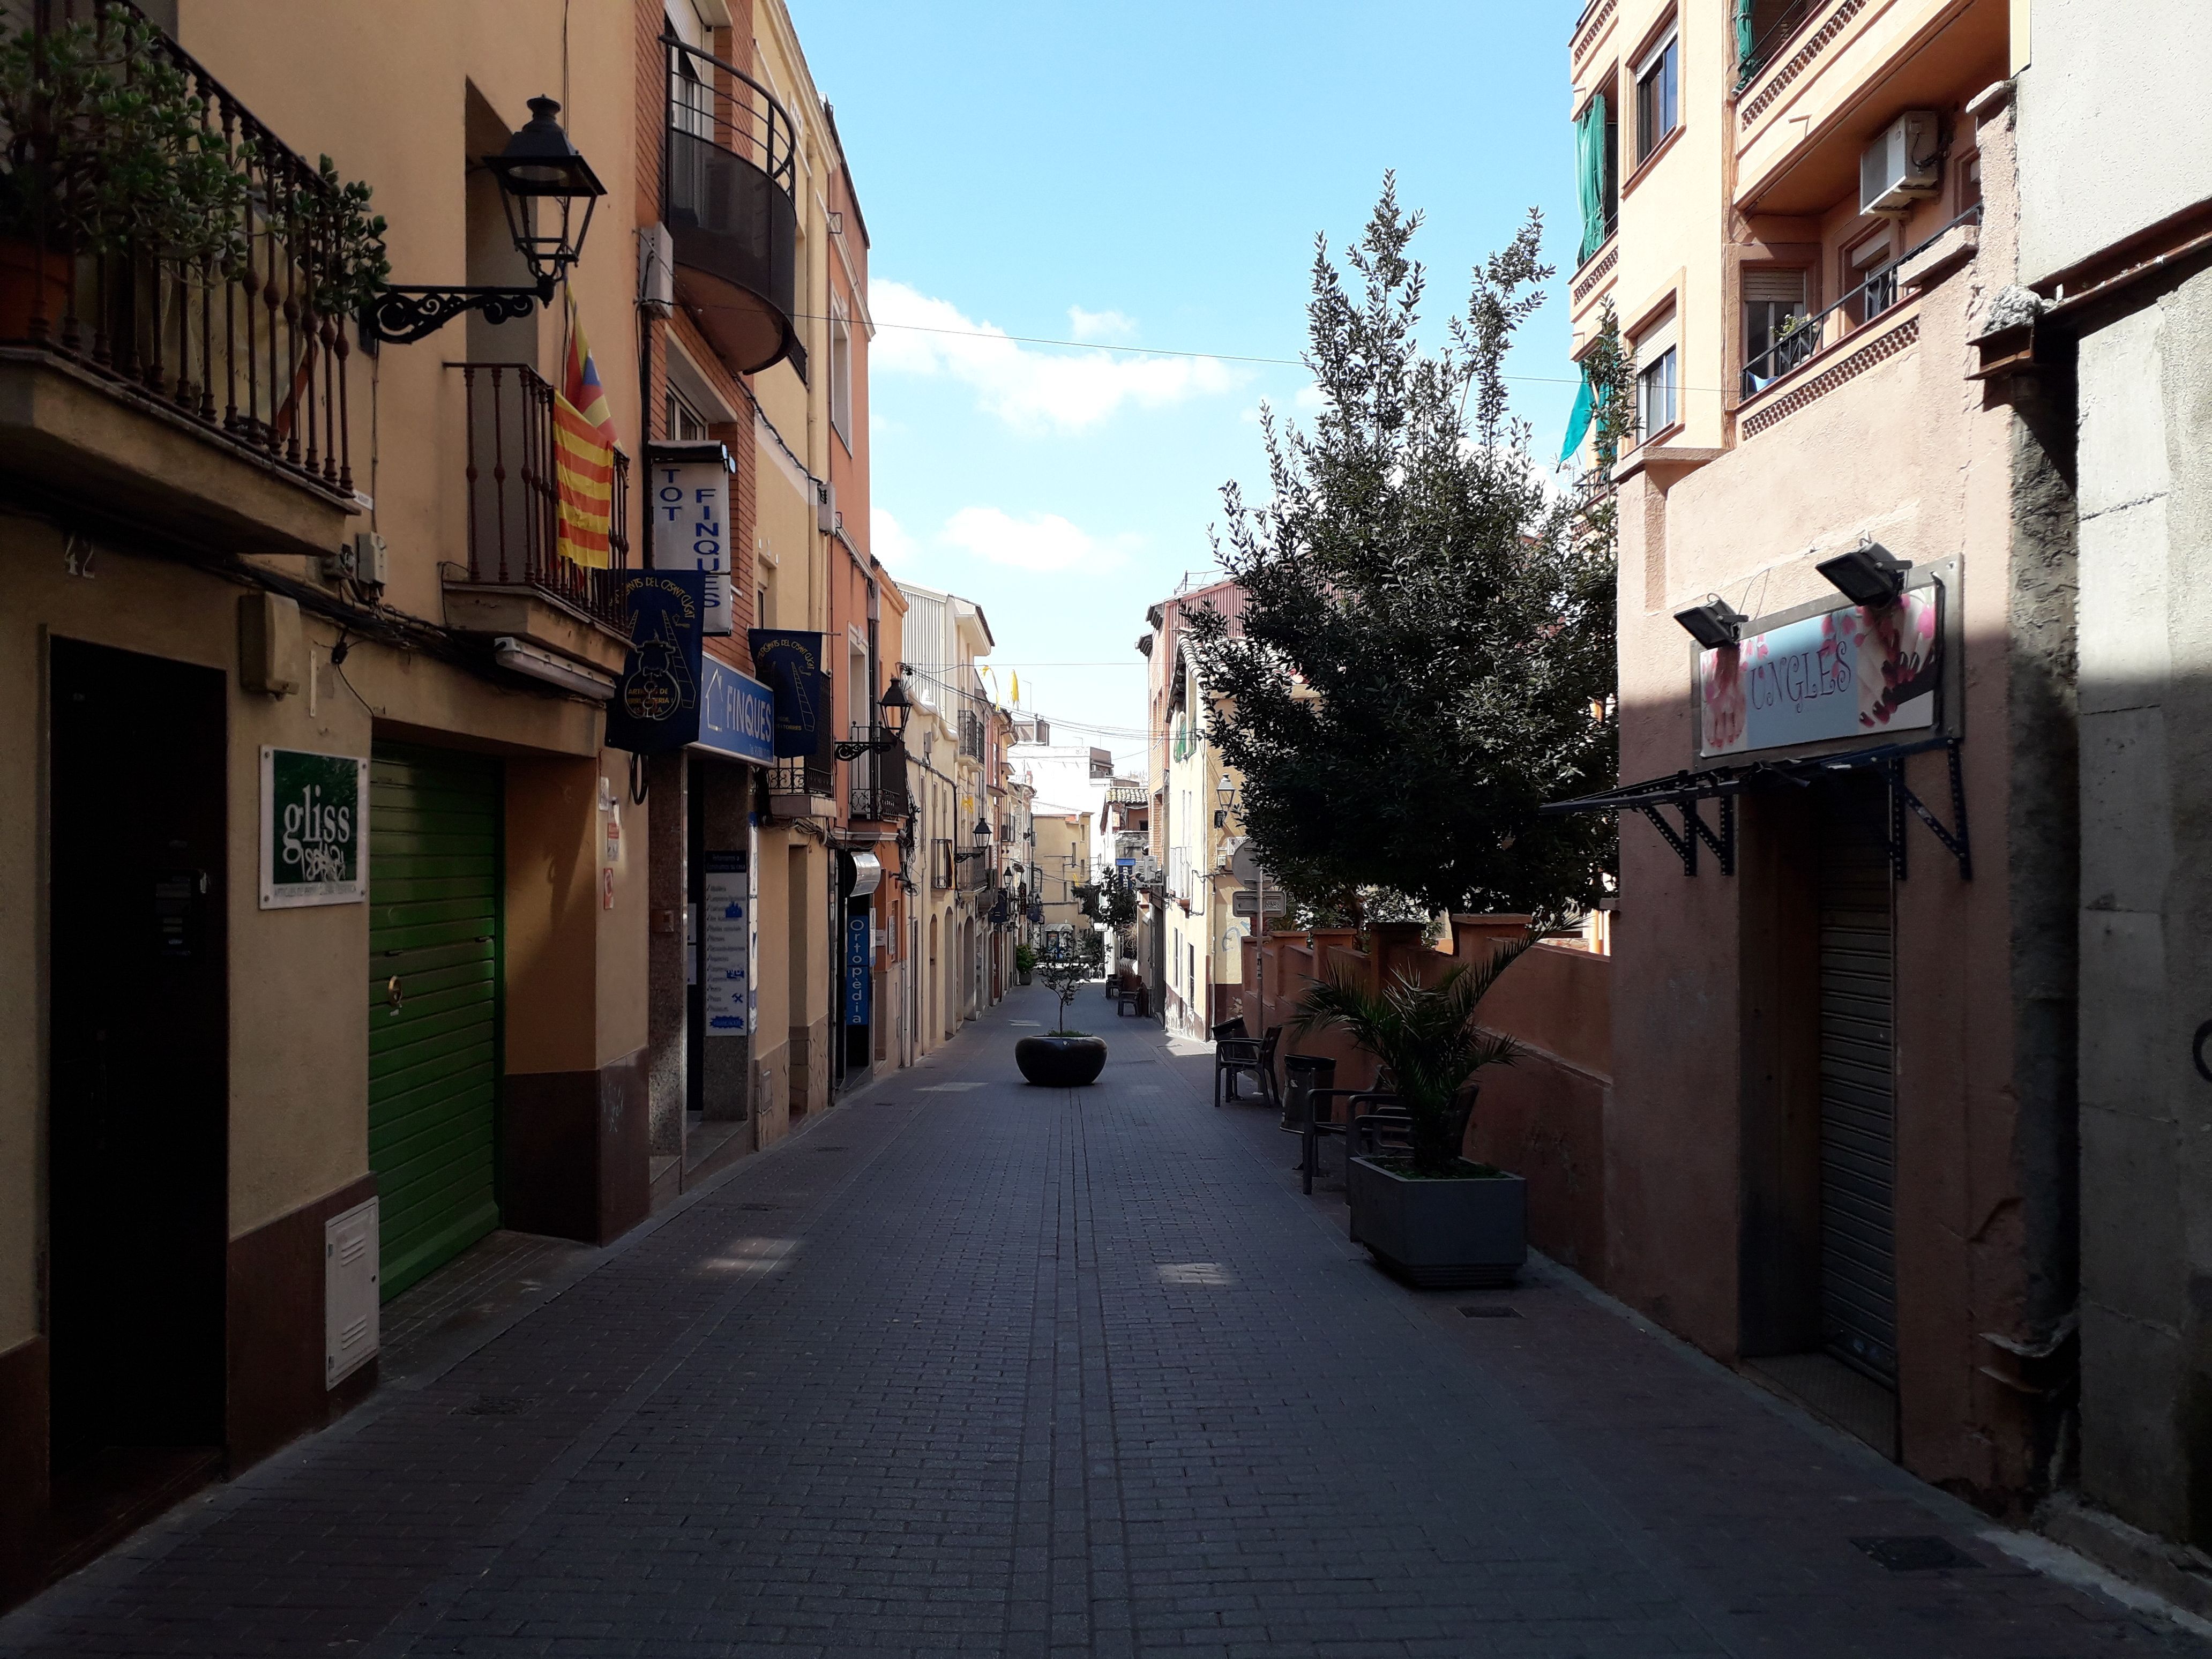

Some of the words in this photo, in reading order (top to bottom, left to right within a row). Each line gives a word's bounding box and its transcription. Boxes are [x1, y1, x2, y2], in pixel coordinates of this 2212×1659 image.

[660, 469, 682, 521] TOT
[694, 490, 720, 608] FINQUES
[646, 577, 659, 587] DEL
[781, 639, 790, 647] DEL
[1751, 641, 1851, 713] UNGLES
[727, 685, 772, 743] FINQUES
[282, 783, 350, 865] gliss
[850, 919, 865, 1023] Ortopèdia
